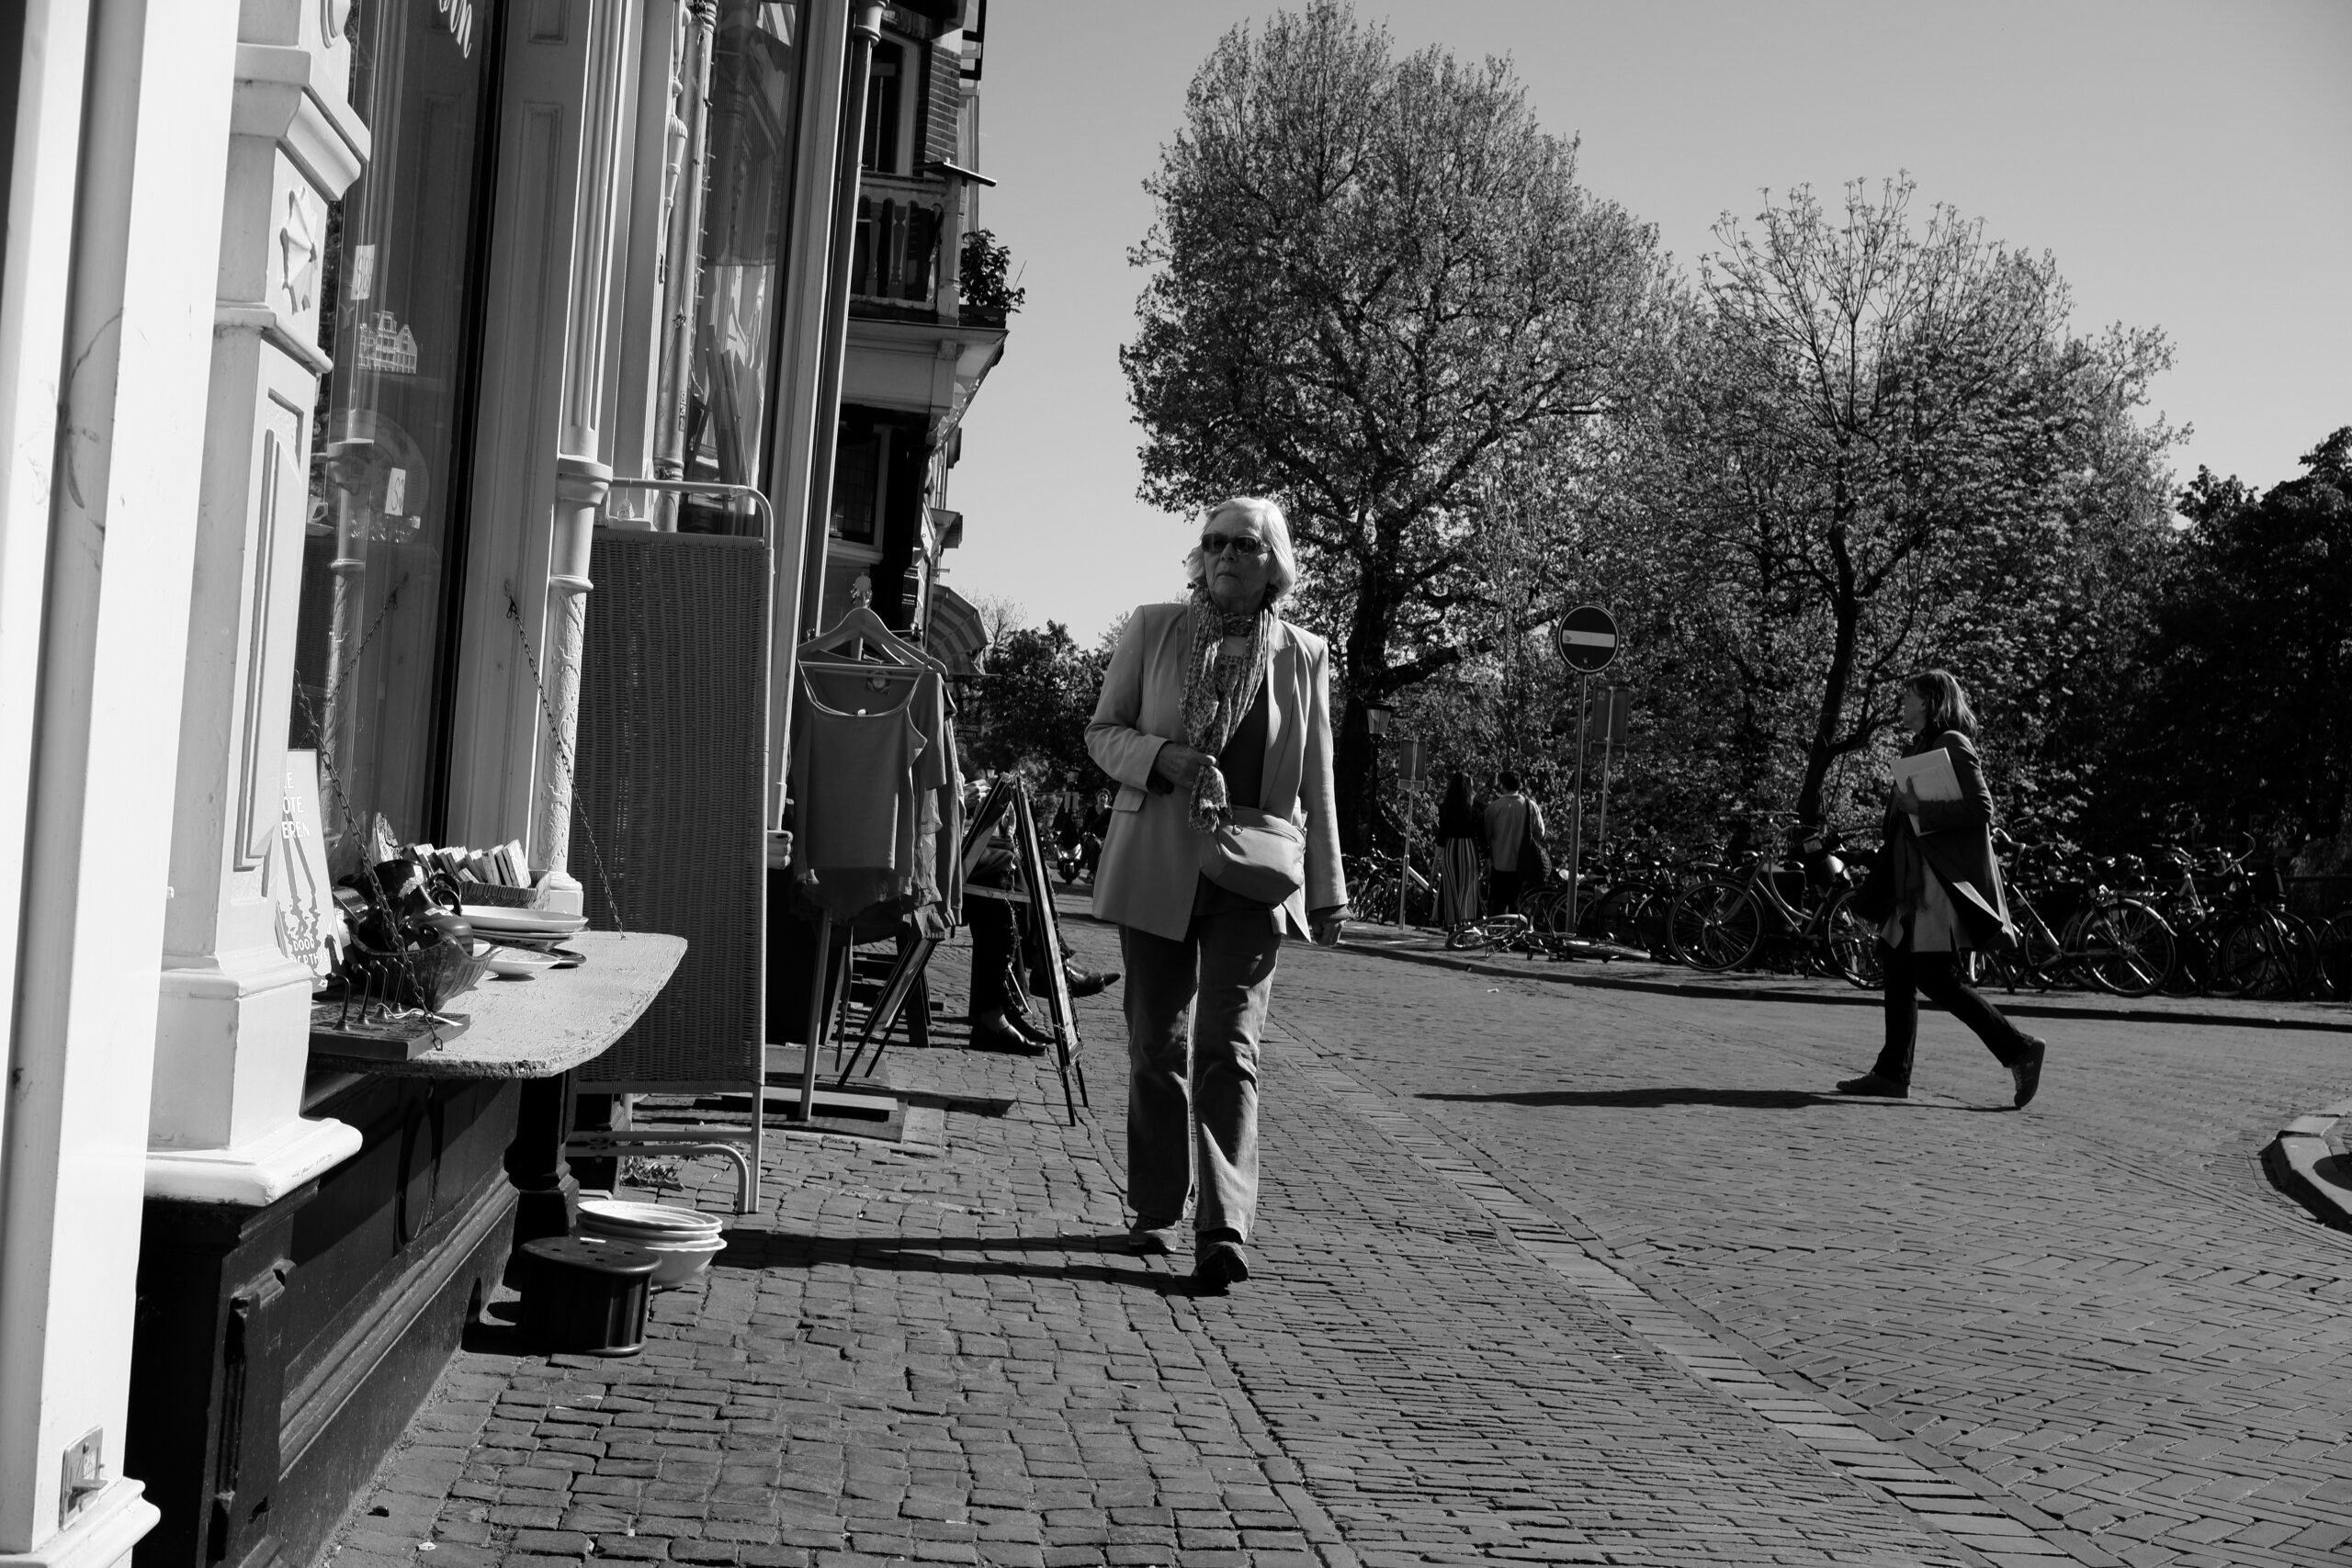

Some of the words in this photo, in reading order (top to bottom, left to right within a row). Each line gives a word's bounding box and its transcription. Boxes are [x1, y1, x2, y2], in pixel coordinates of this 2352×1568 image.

[283, 795, 304, 814] OTE
[281, 819, 311, 839] EREN
[292, 937, 315, 952] DOOR
